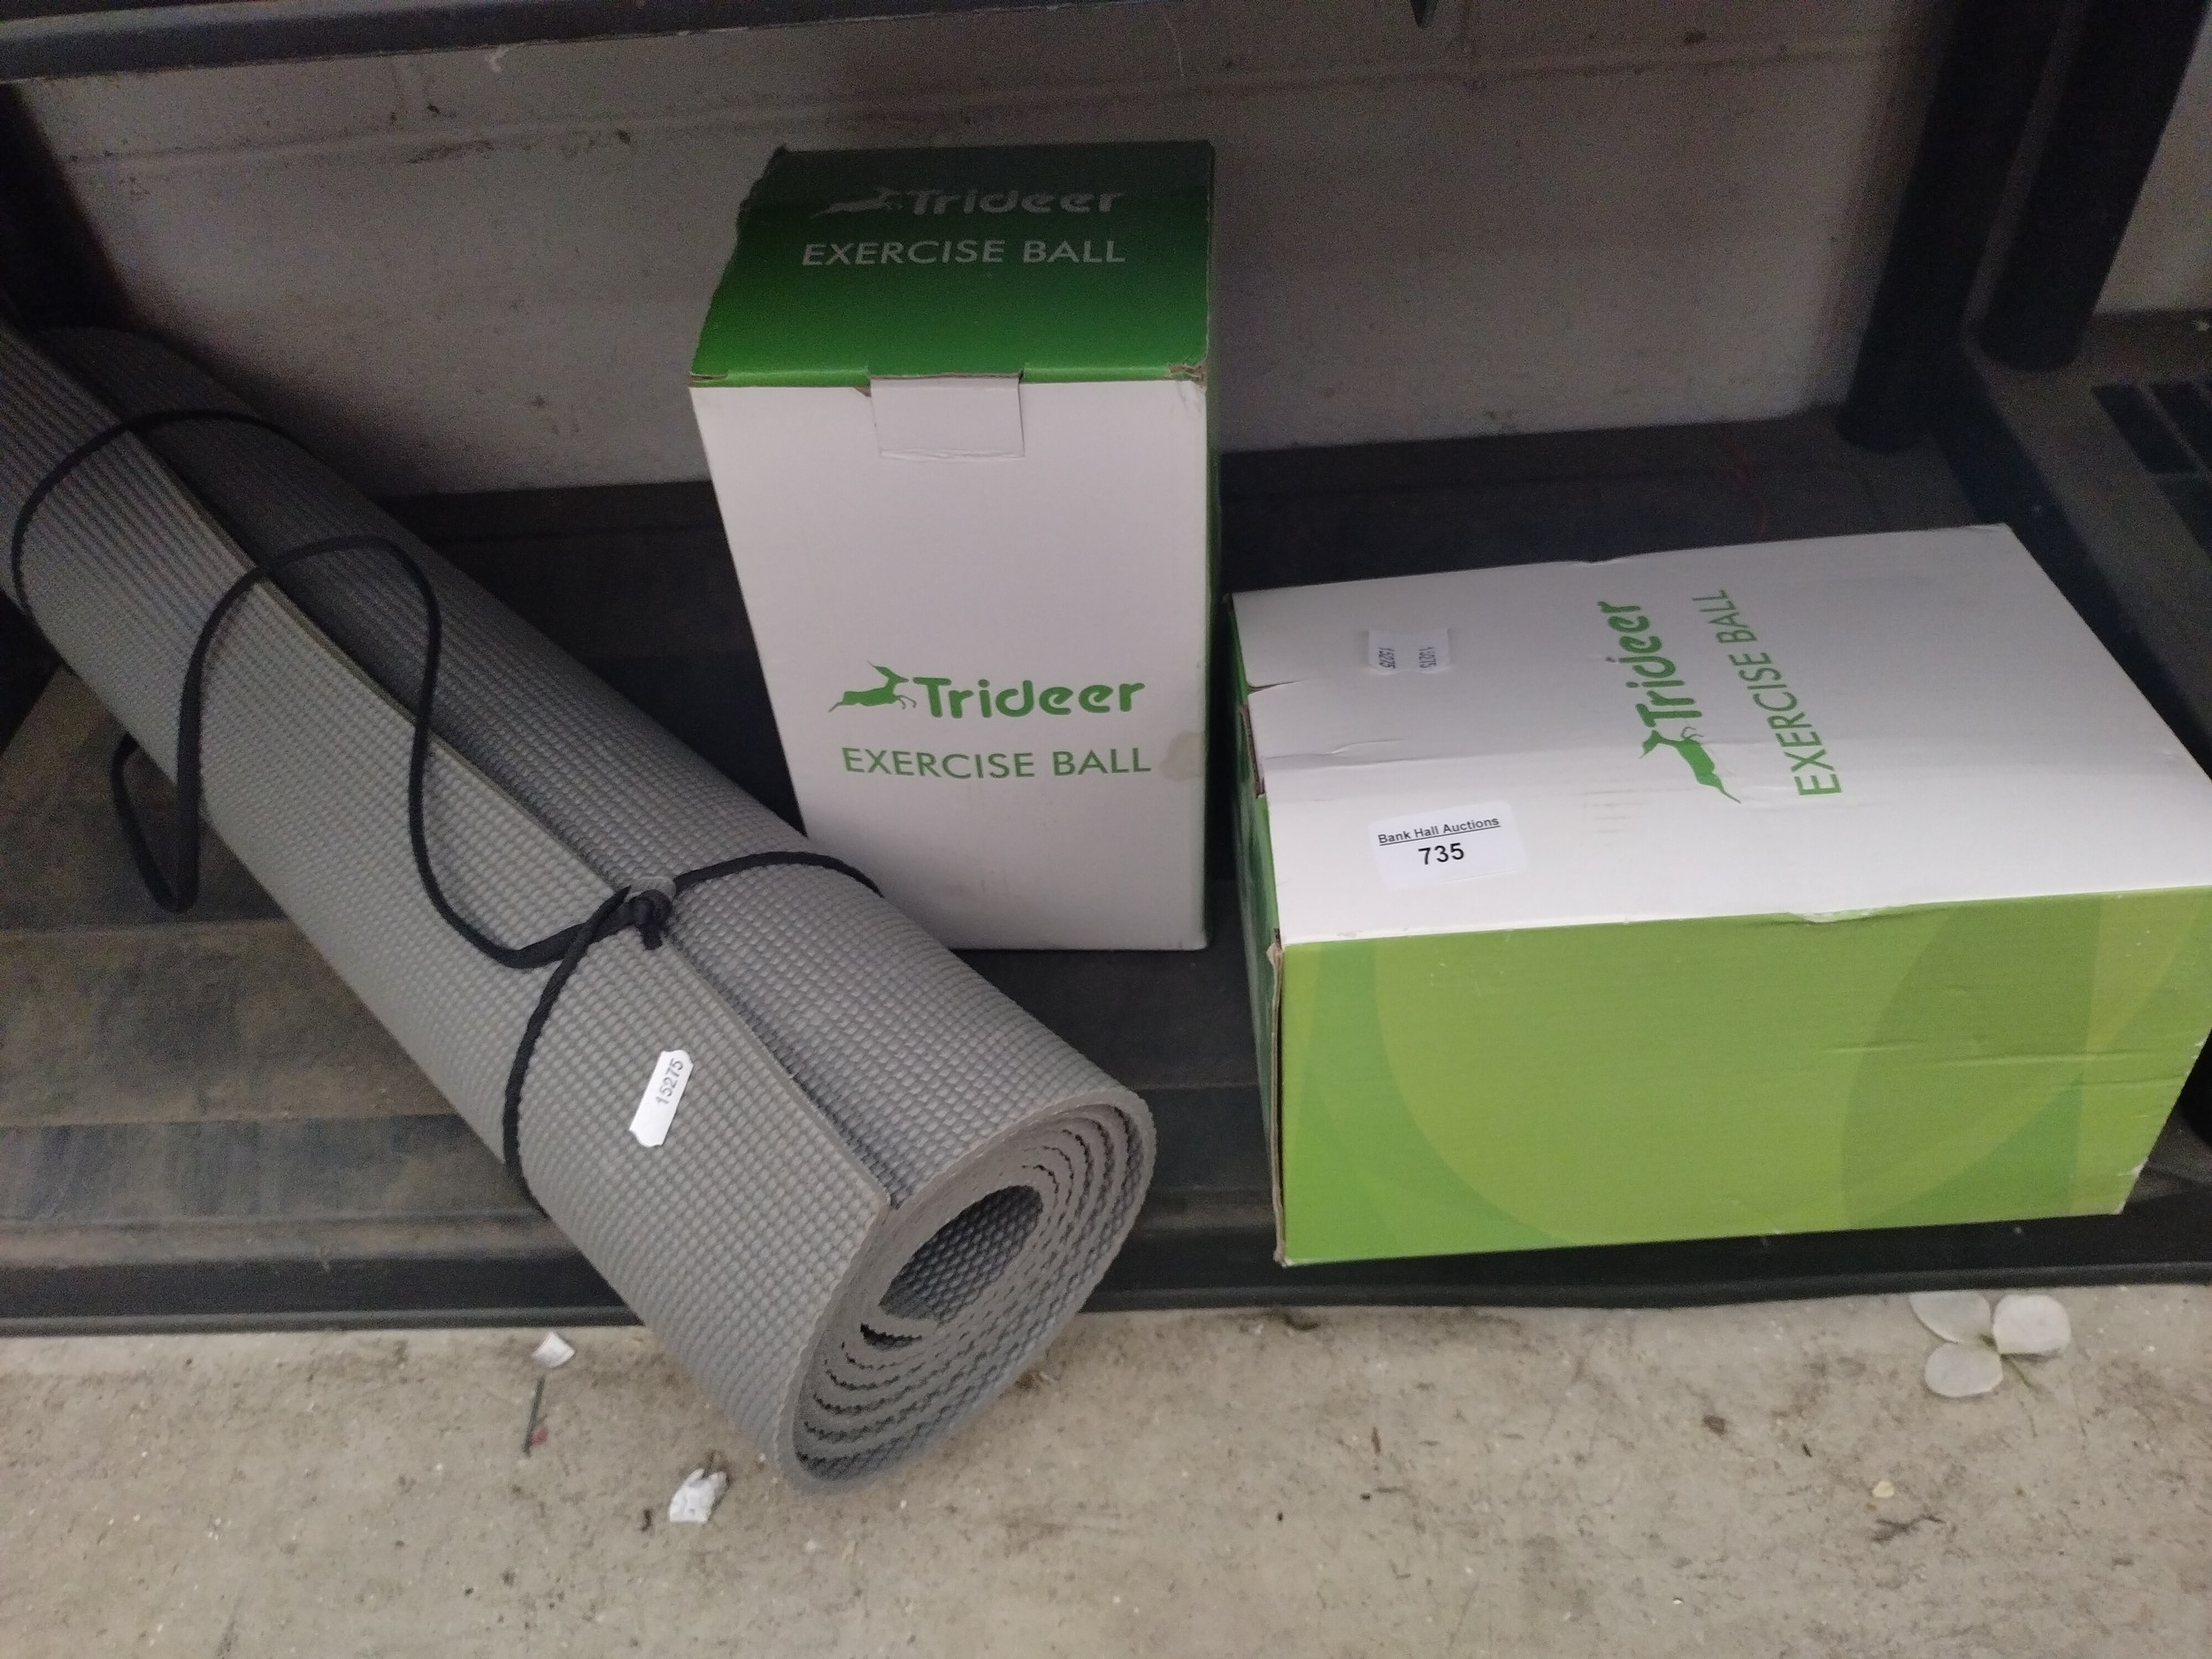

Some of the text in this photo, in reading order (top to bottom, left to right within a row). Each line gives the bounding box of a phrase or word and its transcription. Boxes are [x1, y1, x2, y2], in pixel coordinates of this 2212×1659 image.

[907, 188, 1125, 216] Trideer
[802, 240, 1126, 265] EXERCISE BALL
[1597, 600, 1703, 728] Trideer
[912, 676, 1146, 719] Trideer
[1691, 588, 1842, 796] EXERCISE BALL
[841, 747, 1152, 780] EXERCISE BALL
[1378, 818, 1499, 843] Bank Hall Auctions
[1417, 842, 1464, 864] 735
[656, 1057, 684, 1105] 15275
